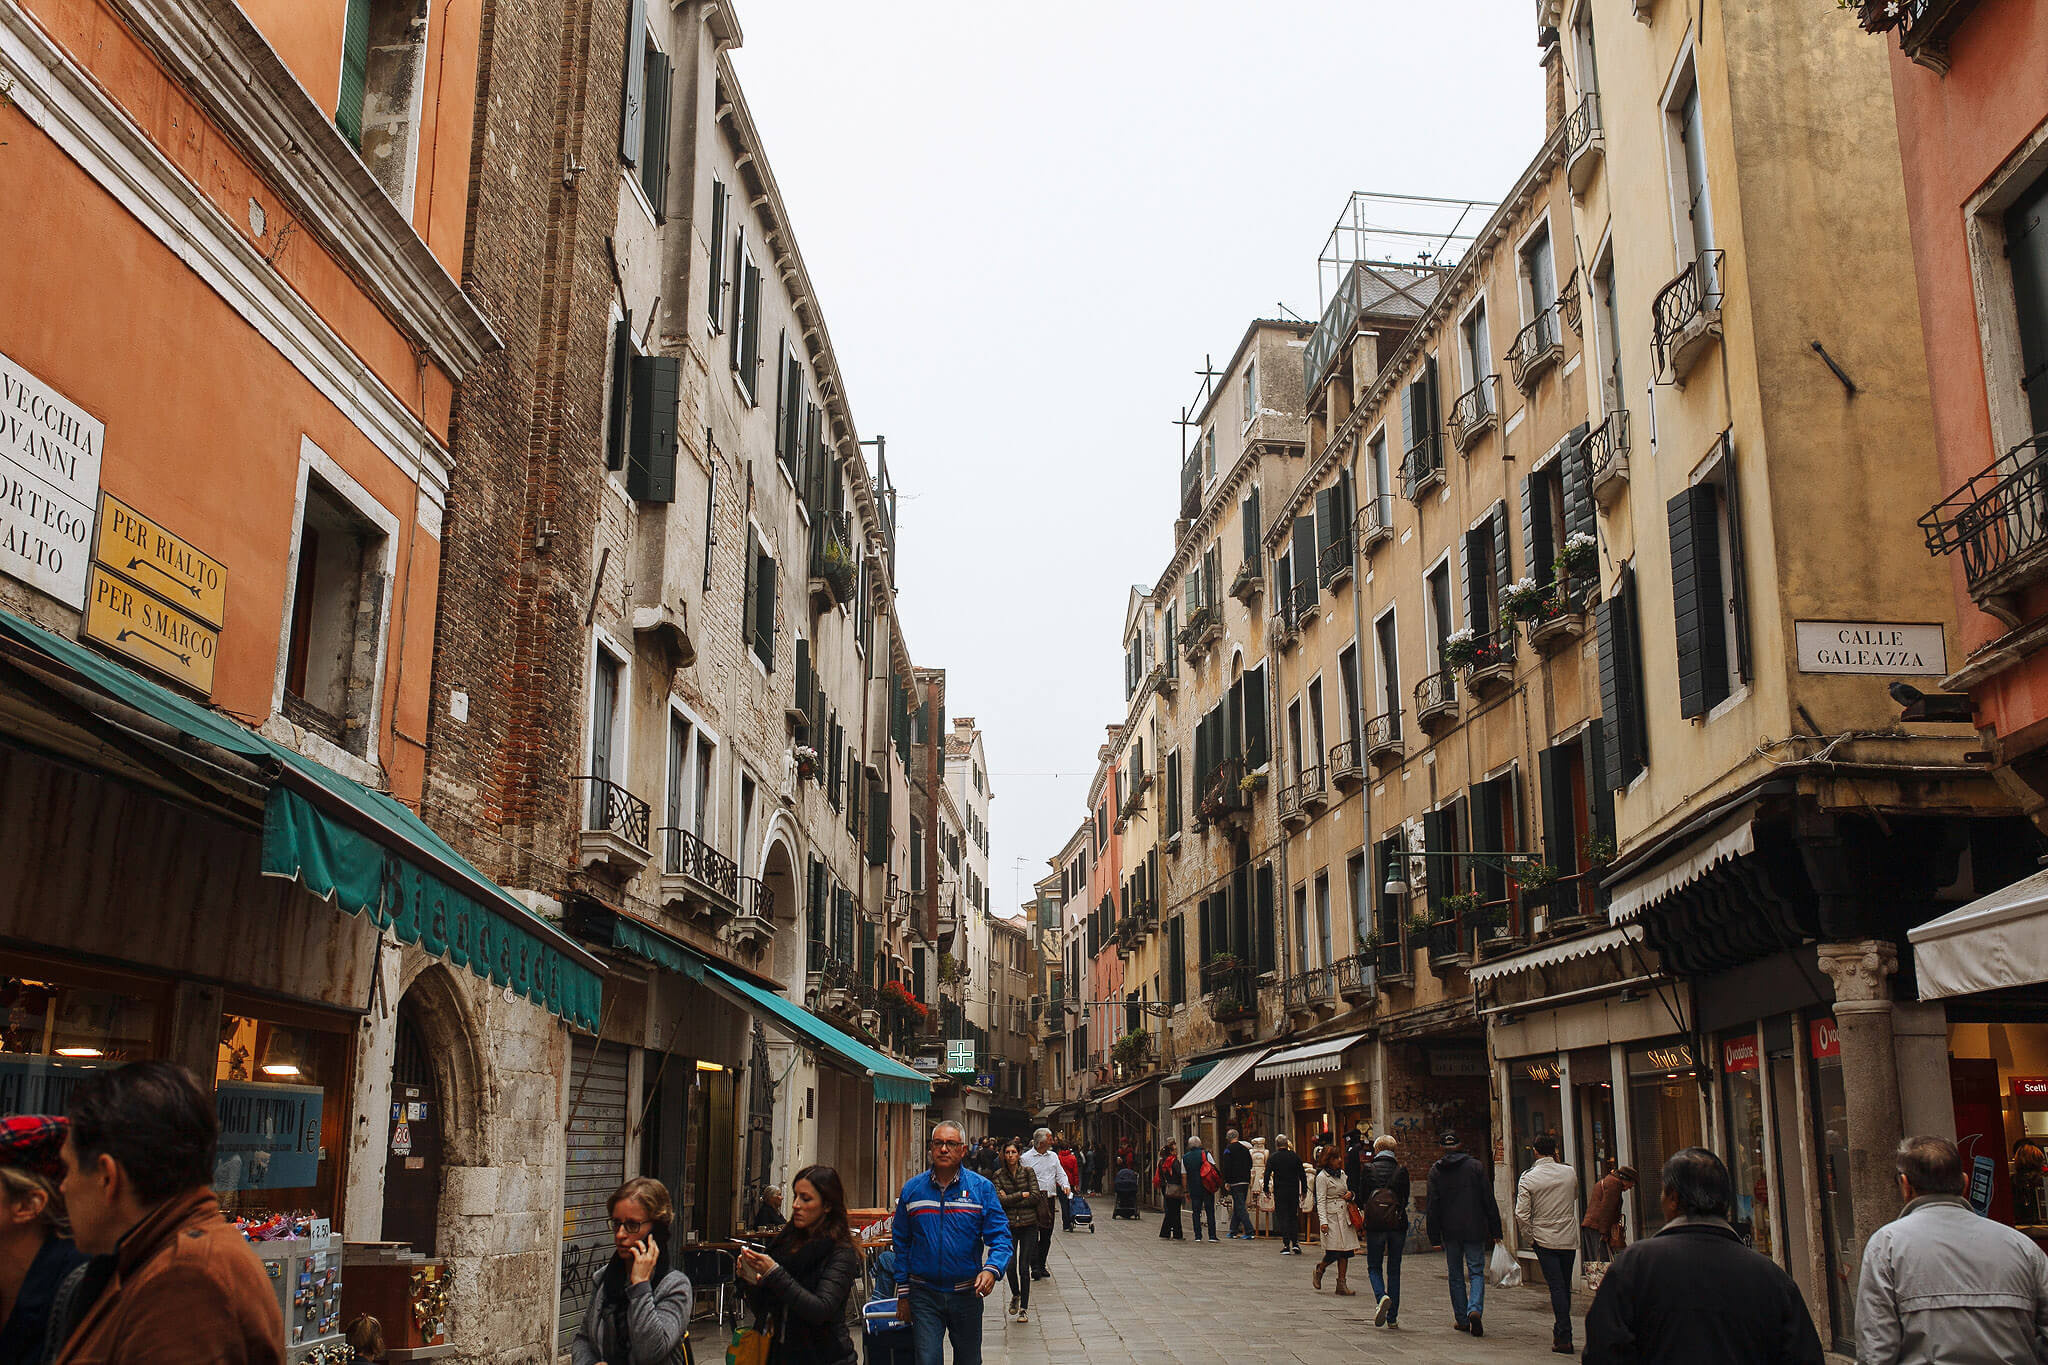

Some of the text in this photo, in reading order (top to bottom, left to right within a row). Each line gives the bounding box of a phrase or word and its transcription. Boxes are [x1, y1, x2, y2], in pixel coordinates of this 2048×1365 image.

[3, 372, 92, 456] VECCHIA
[0, 518, 62, 574] ALTO
[114, 508, 218, 590] PER RIALTO
[97, 579, 213, 660] PER S.MARCO
[1838, 630, 1903, 646] CALLE
[1817, 649, 1925, 668] GALEAZZA
[1648, 1050, 1680, 1072] Style
[1732, 1044, 1753, 1060] vodafone
[1527, 1064, 1550, 1084] Style
[2024, 1083, 2047, 1092] Scelti
[220, 1096, 252, 1134] OGGI
